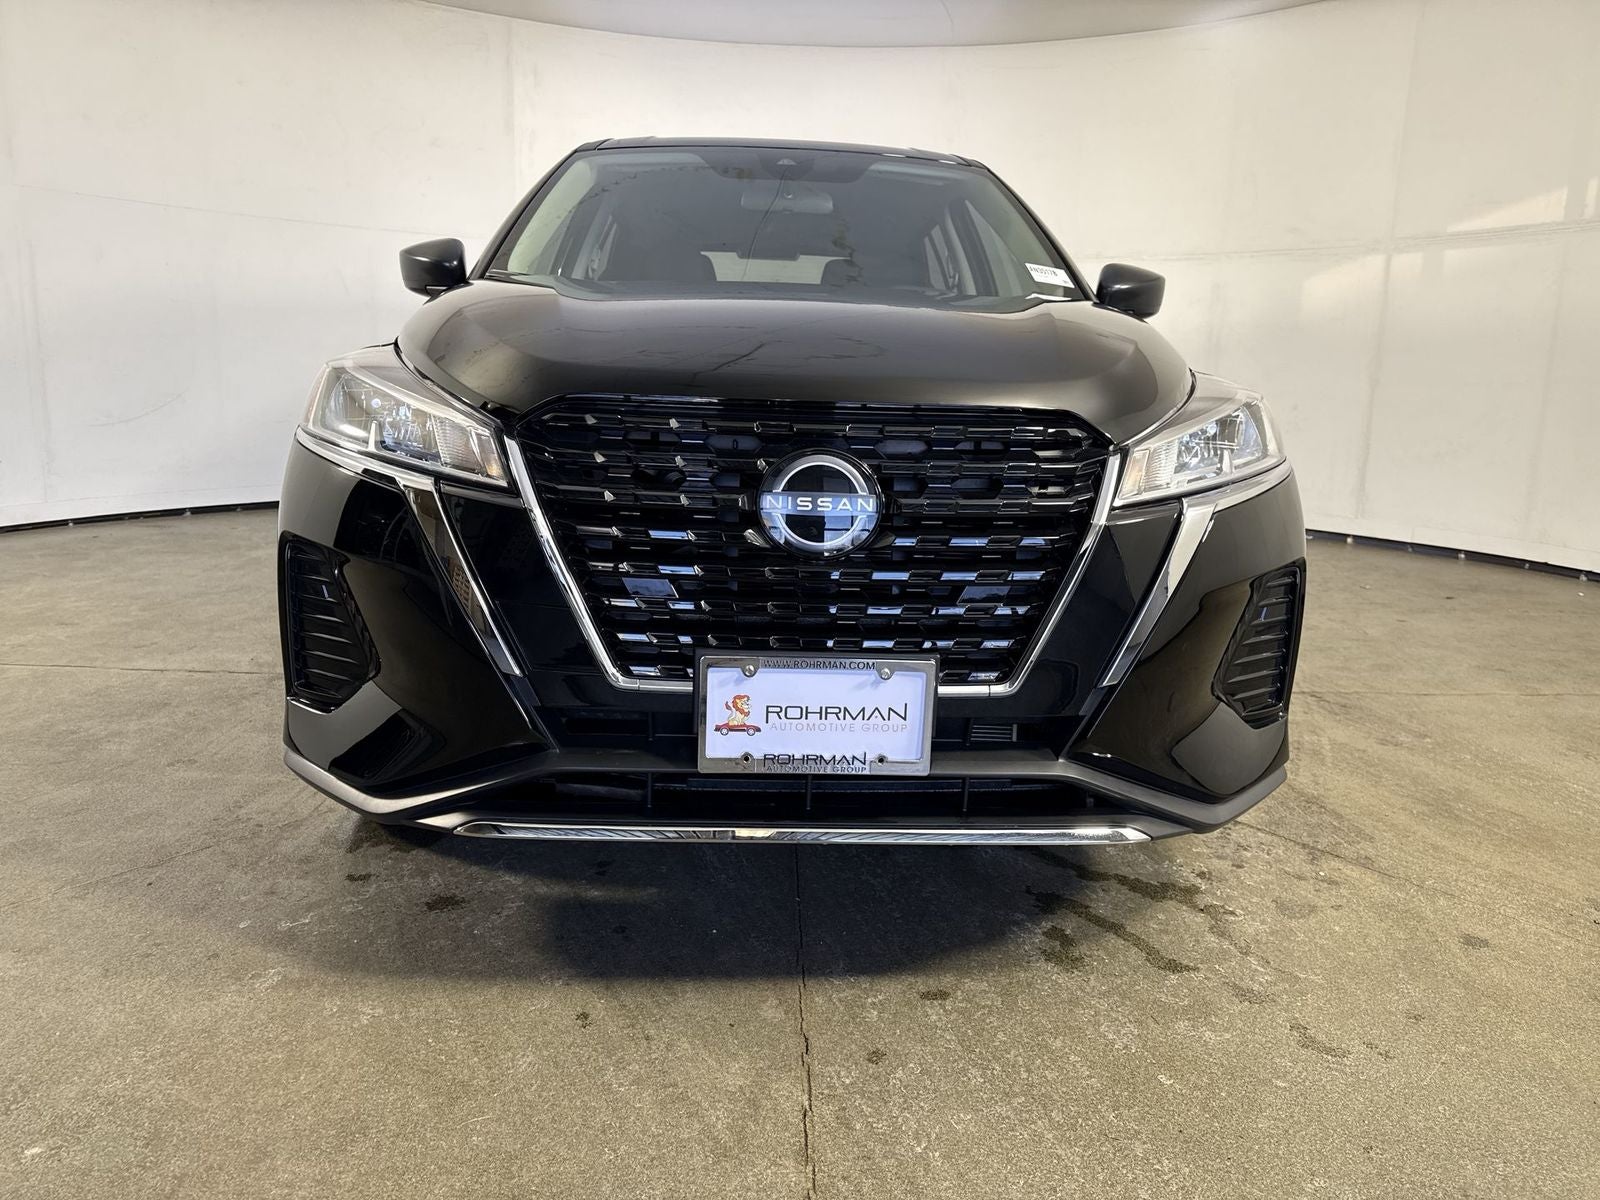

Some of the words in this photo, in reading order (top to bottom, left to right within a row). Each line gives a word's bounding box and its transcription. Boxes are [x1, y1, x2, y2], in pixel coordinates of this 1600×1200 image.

[766, 495, 873, 512] NISSAN
[763, 659, 876, 670] WWW.ROHRMAN.COM
[765, 703, 908, 724] ROHRMAN
[769, 723, 856, 732] AUTOMOTIVE
[861, 723, 908, 733] GROUP
[763, 752, 867, 767] ROHRMAN
[766, 765, 828, 773] AUTOMOTIVE
